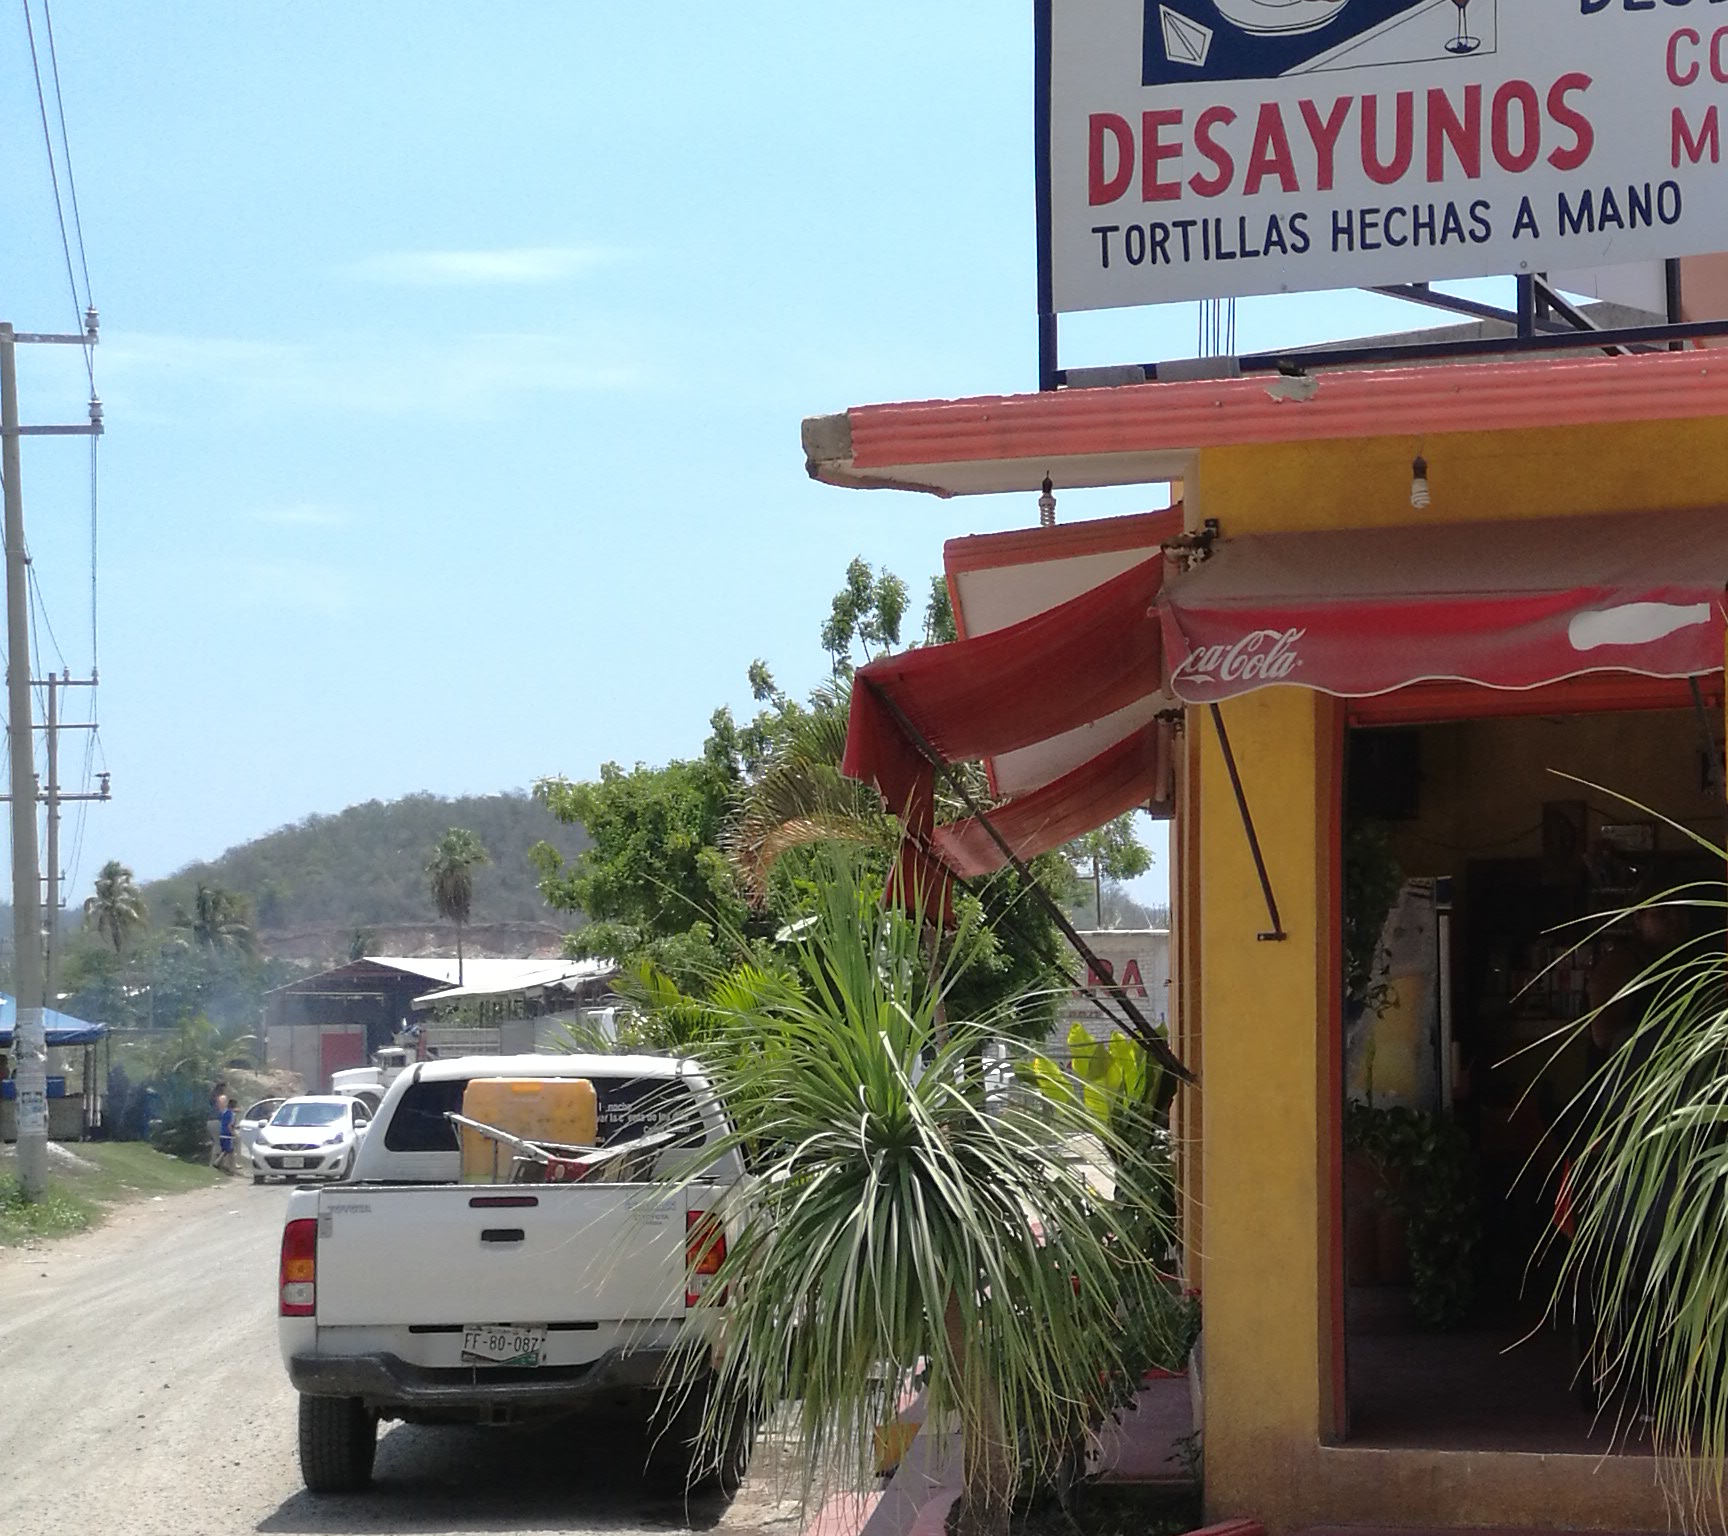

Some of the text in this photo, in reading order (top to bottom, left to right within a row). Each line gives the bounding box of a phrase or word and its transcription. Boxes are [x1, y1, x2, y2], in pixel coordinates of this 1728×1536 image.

[1088, 72, 1595, 207] DESAYUNOS
[1092, 180, 1683, 269] TORTILLAS HECHAS A MANO
[464, 1333, 539, 1352] FF-80-087
